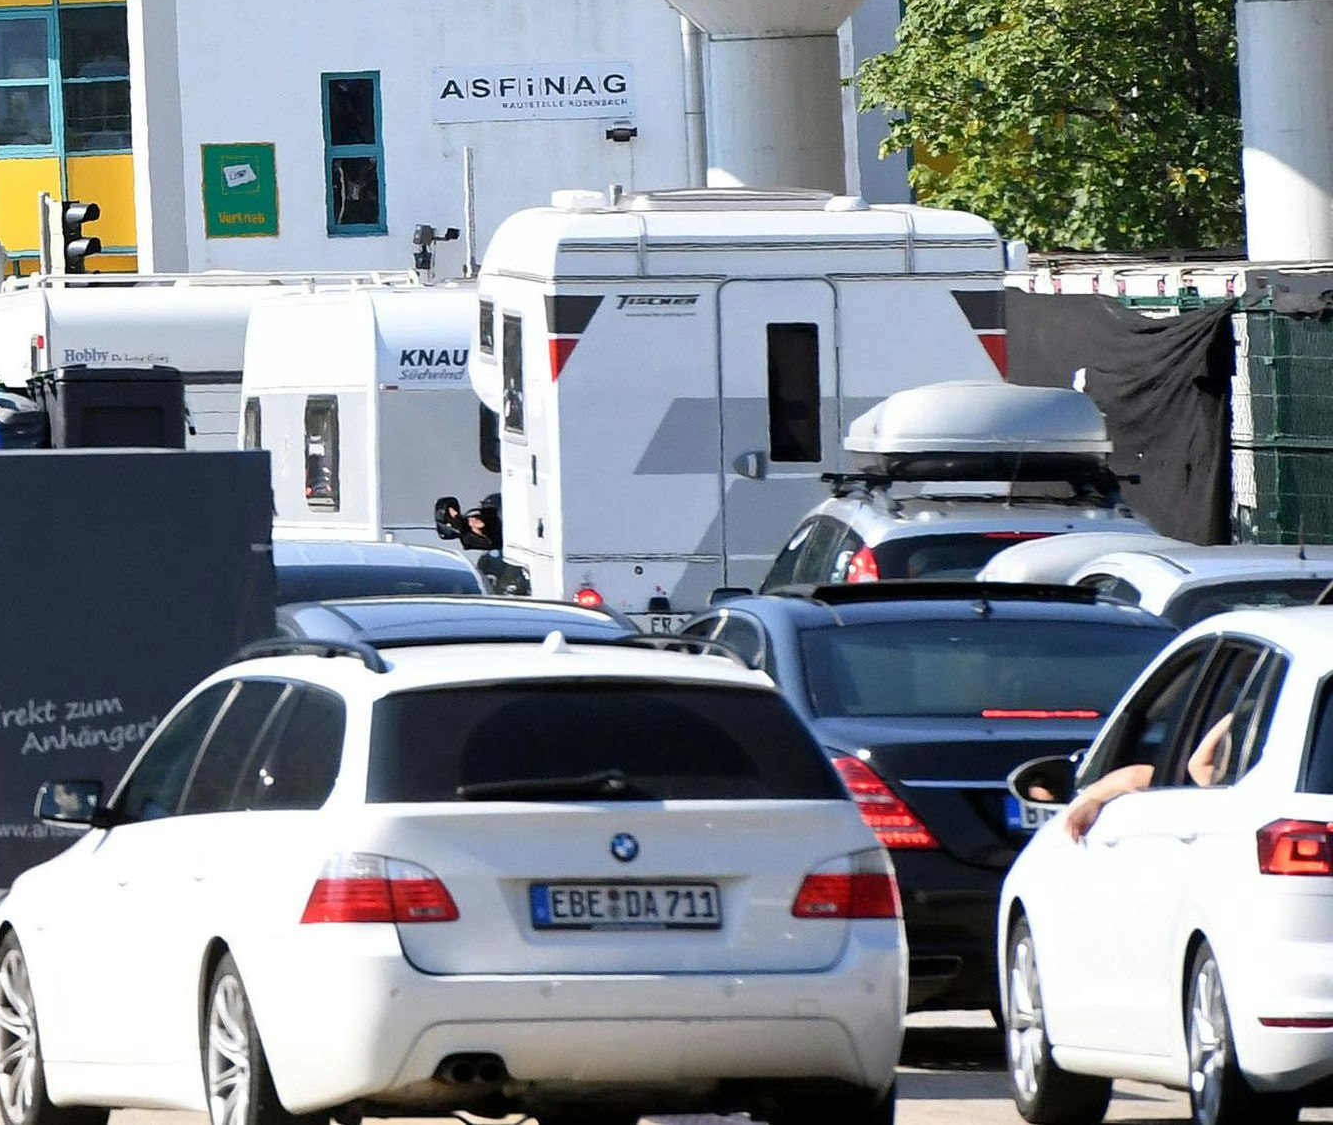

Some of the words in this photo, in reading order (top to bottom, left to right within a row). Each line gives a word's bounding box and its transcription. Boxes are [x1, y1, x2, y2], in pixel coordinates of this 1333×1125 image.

[64, 349, 109, 365] Hobby
[398, 368, 465, 380] Südwind
[65, 697, 124, 721] zum
[552, 890, 603, 918] EBE
[625, 890, 659, 917] DA
[666, 890, 715, 917] 711
